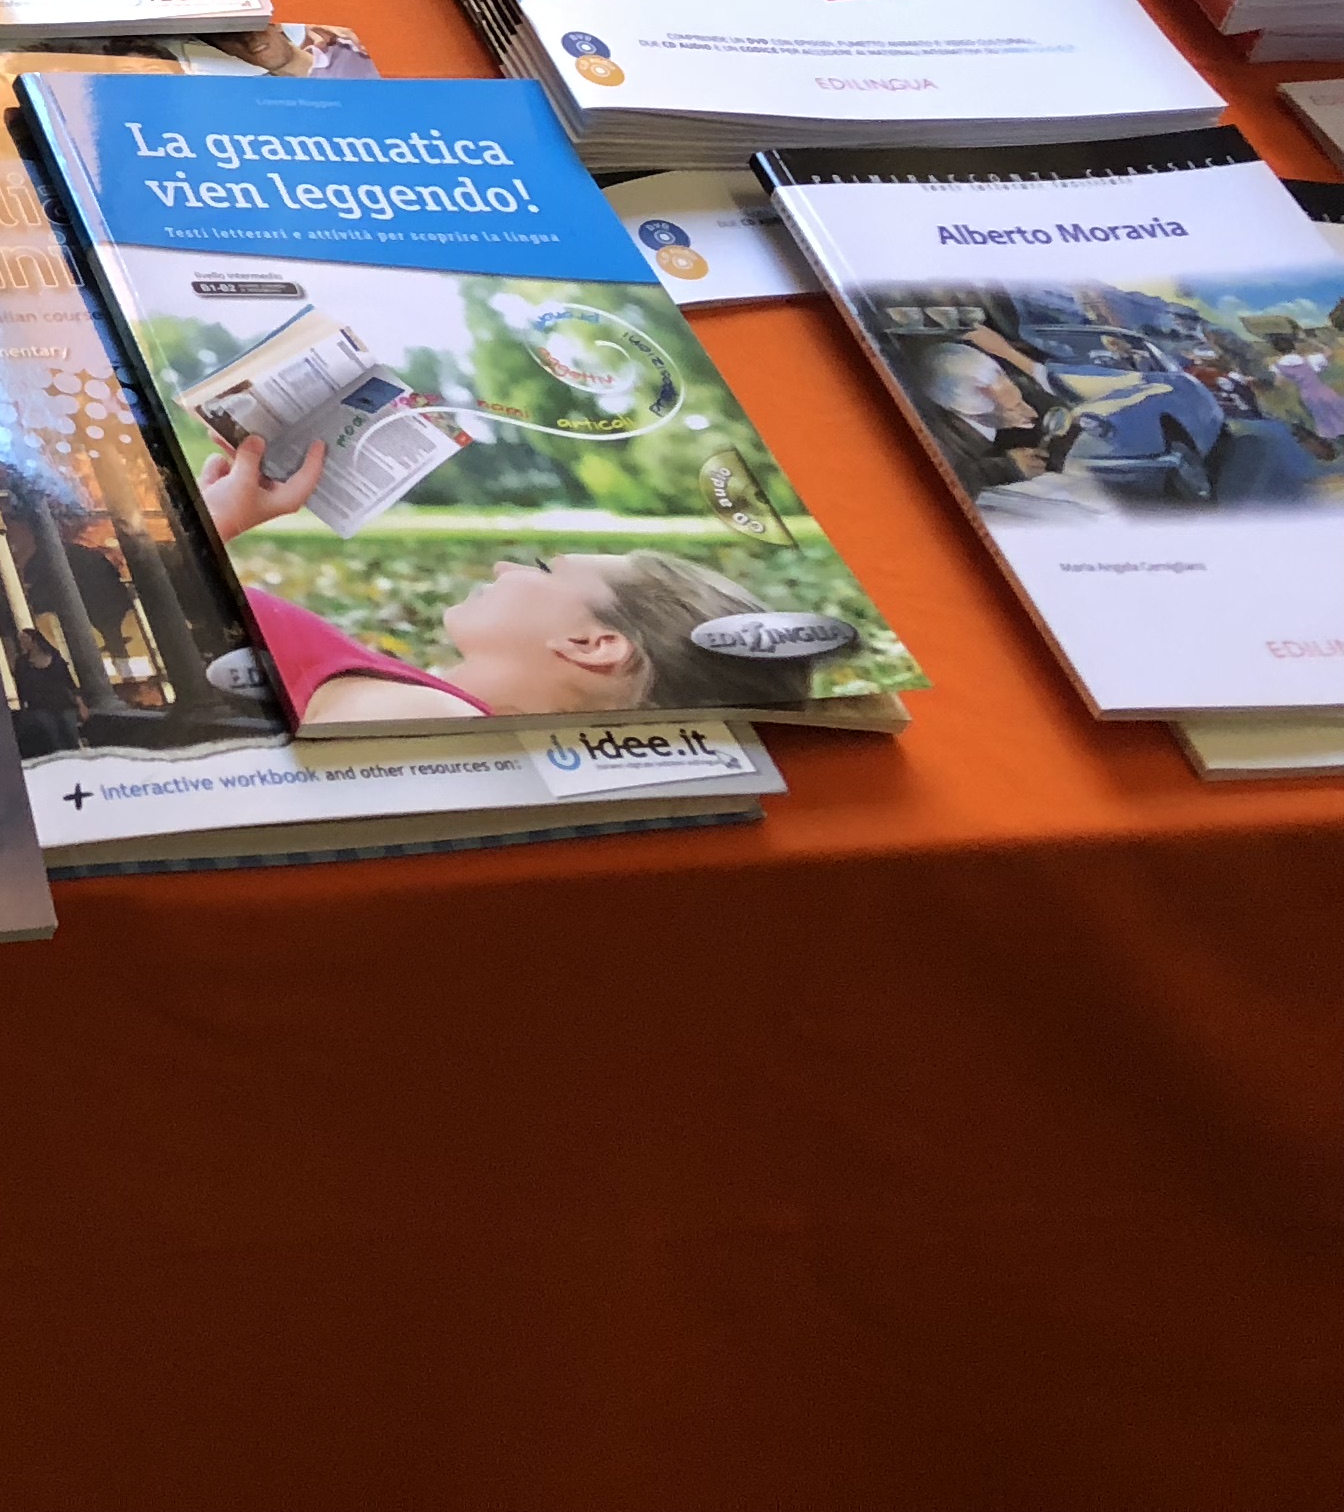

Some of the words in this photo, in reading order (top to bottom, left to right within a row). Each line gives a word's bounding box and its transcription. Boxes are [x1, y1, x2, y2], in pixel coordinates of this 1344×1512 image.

[126, 122, 196, 159] La
[206, 129, 514, 168] grammatica
[146, 172, 269, 210] vien
[273, 172, 542, 220] leggendo!
[307, 228, 373, 242] attività
[503, 230, 560, 244] lingua
[936, 221, 1052, 248] Alberto
[1059, 217, 1189, 242] Moravia
[98, 774, 214, 801] interactive
[220, 767, 319, 791] workbook
